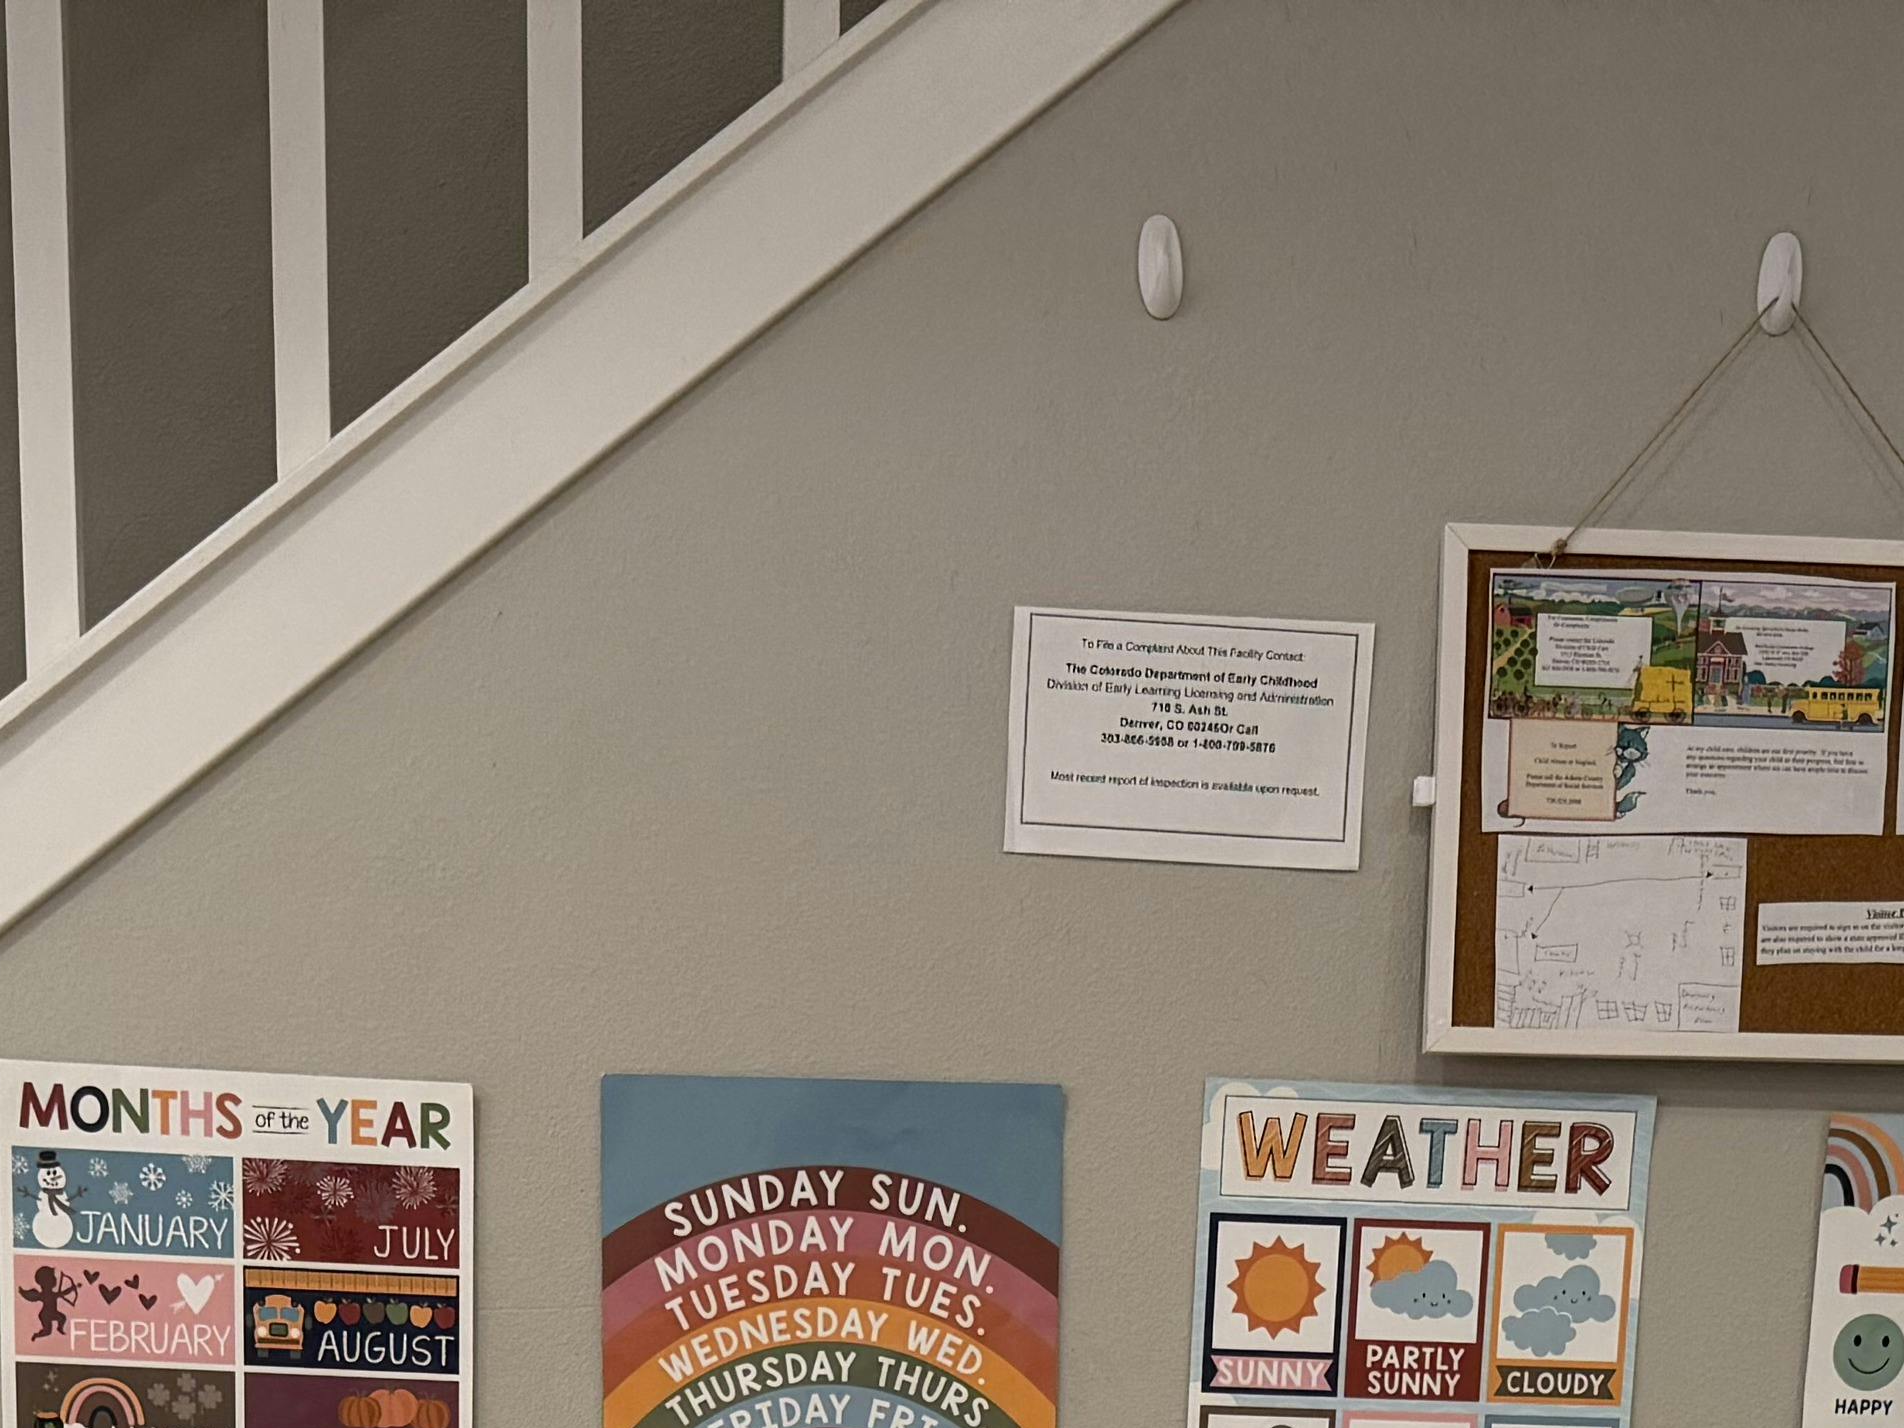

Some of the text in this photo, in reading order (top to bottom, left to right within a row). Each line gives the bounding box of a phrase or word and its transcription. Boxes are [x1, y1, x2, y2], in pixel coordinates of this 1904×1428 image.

[19, 1082, 451, 1150] MONTHS of the YEAR
[1238, 1111, 1614, 1196] WEATHER
[664, 1170, 967, 1237] SUNDAY SUN.
[76, 1211, 228, 1250] JANUARY
[373, 1225, 454, 1261] JULY
[654, 1216, 994, 1294] MONDAY MON.
[665, 1262, 985, 1336] TUESDAY TUES.
[69, 1319, 230, 1356] FEBRUARY
[317, 1330, 454, 1367] AUGUST
[658, 1307, 985, 1386] WEDNESDAY WED.
[1217, 1358, 1327, 1388] SUNNY
[1366, 1345, 1466, 1371] PARTLY
[665, 1350, 856, 1426] THURSDAY
[1368, 1371, 1461, 1397] SUNNY
[1506, 1371, 1605, 1397] CLOUDY
[1834, 1399, 1894, 1416] HAPPY
